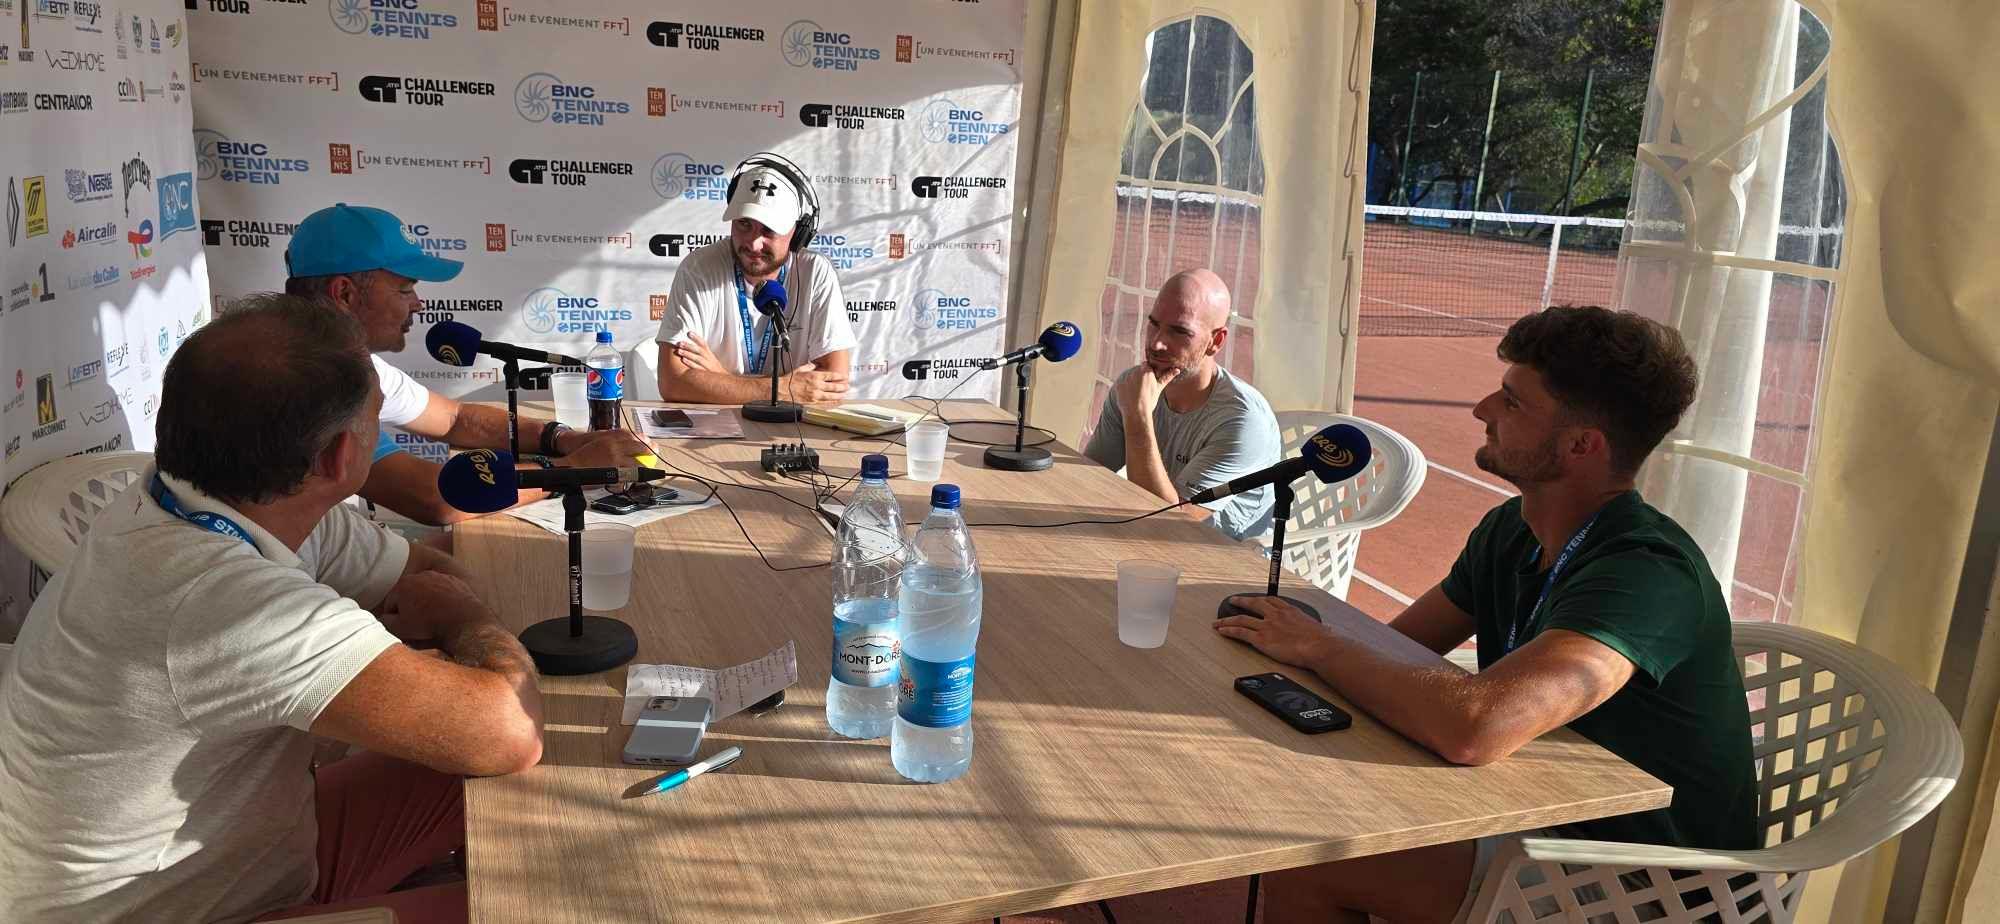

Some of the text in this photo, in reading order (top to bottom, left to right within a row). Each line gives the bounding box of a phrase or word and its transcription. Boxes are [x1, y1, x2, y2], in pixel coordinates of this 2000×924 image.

[209, 0, 250, 14] TOUR
[371, 9, 457, 27] TENNIS
[686, 24, 764, 41] CHALLENGER
[813, 31, 850, 45] BNC
[686, 37, 720, 51] TOUR
[813, 44, 880, 60] TENNIS
[405, 78, 495, 96] CHALLENGER
[551, 84, 595, 98] BNC
[34, 94, 93, 110] CENTRAKOR
[405, 92, 444, 106] TOUR
[552, 99, 630, 113] TENNIS
[835, 105, 905, 120] CHALLENGER
[949, 110, 983, 121] BNC
[835, 118, 865, 129] TOUR
[949, 122, 1009, 134] TENNIS
[217, 141, 268, 156] BNC
[218, 156, 310, 172] TENNIS
[551, 160, 633, 175] CHALLENGER
[684, 163, 724, 176] BNC
[552, 173, 587, 186] TOUR
[684, 176, 729, 189] TENN
[944, 176, 1006, 188] CHALLENGER
[943, 188, 969, 198] TOUR
[78, 222, 117, 243] Aircalin
[229, 234, 270, 248] TOUR
[557, 297, 599, 309] BNC
[846, 301, 896, 311] ALLENGER
[937, 298, 970, 307] BNC
[557, 310, 632, 321] TENNIS
[937, 309, 996, 318] TENNIS
[933, 370, 958, 379] TOUR
